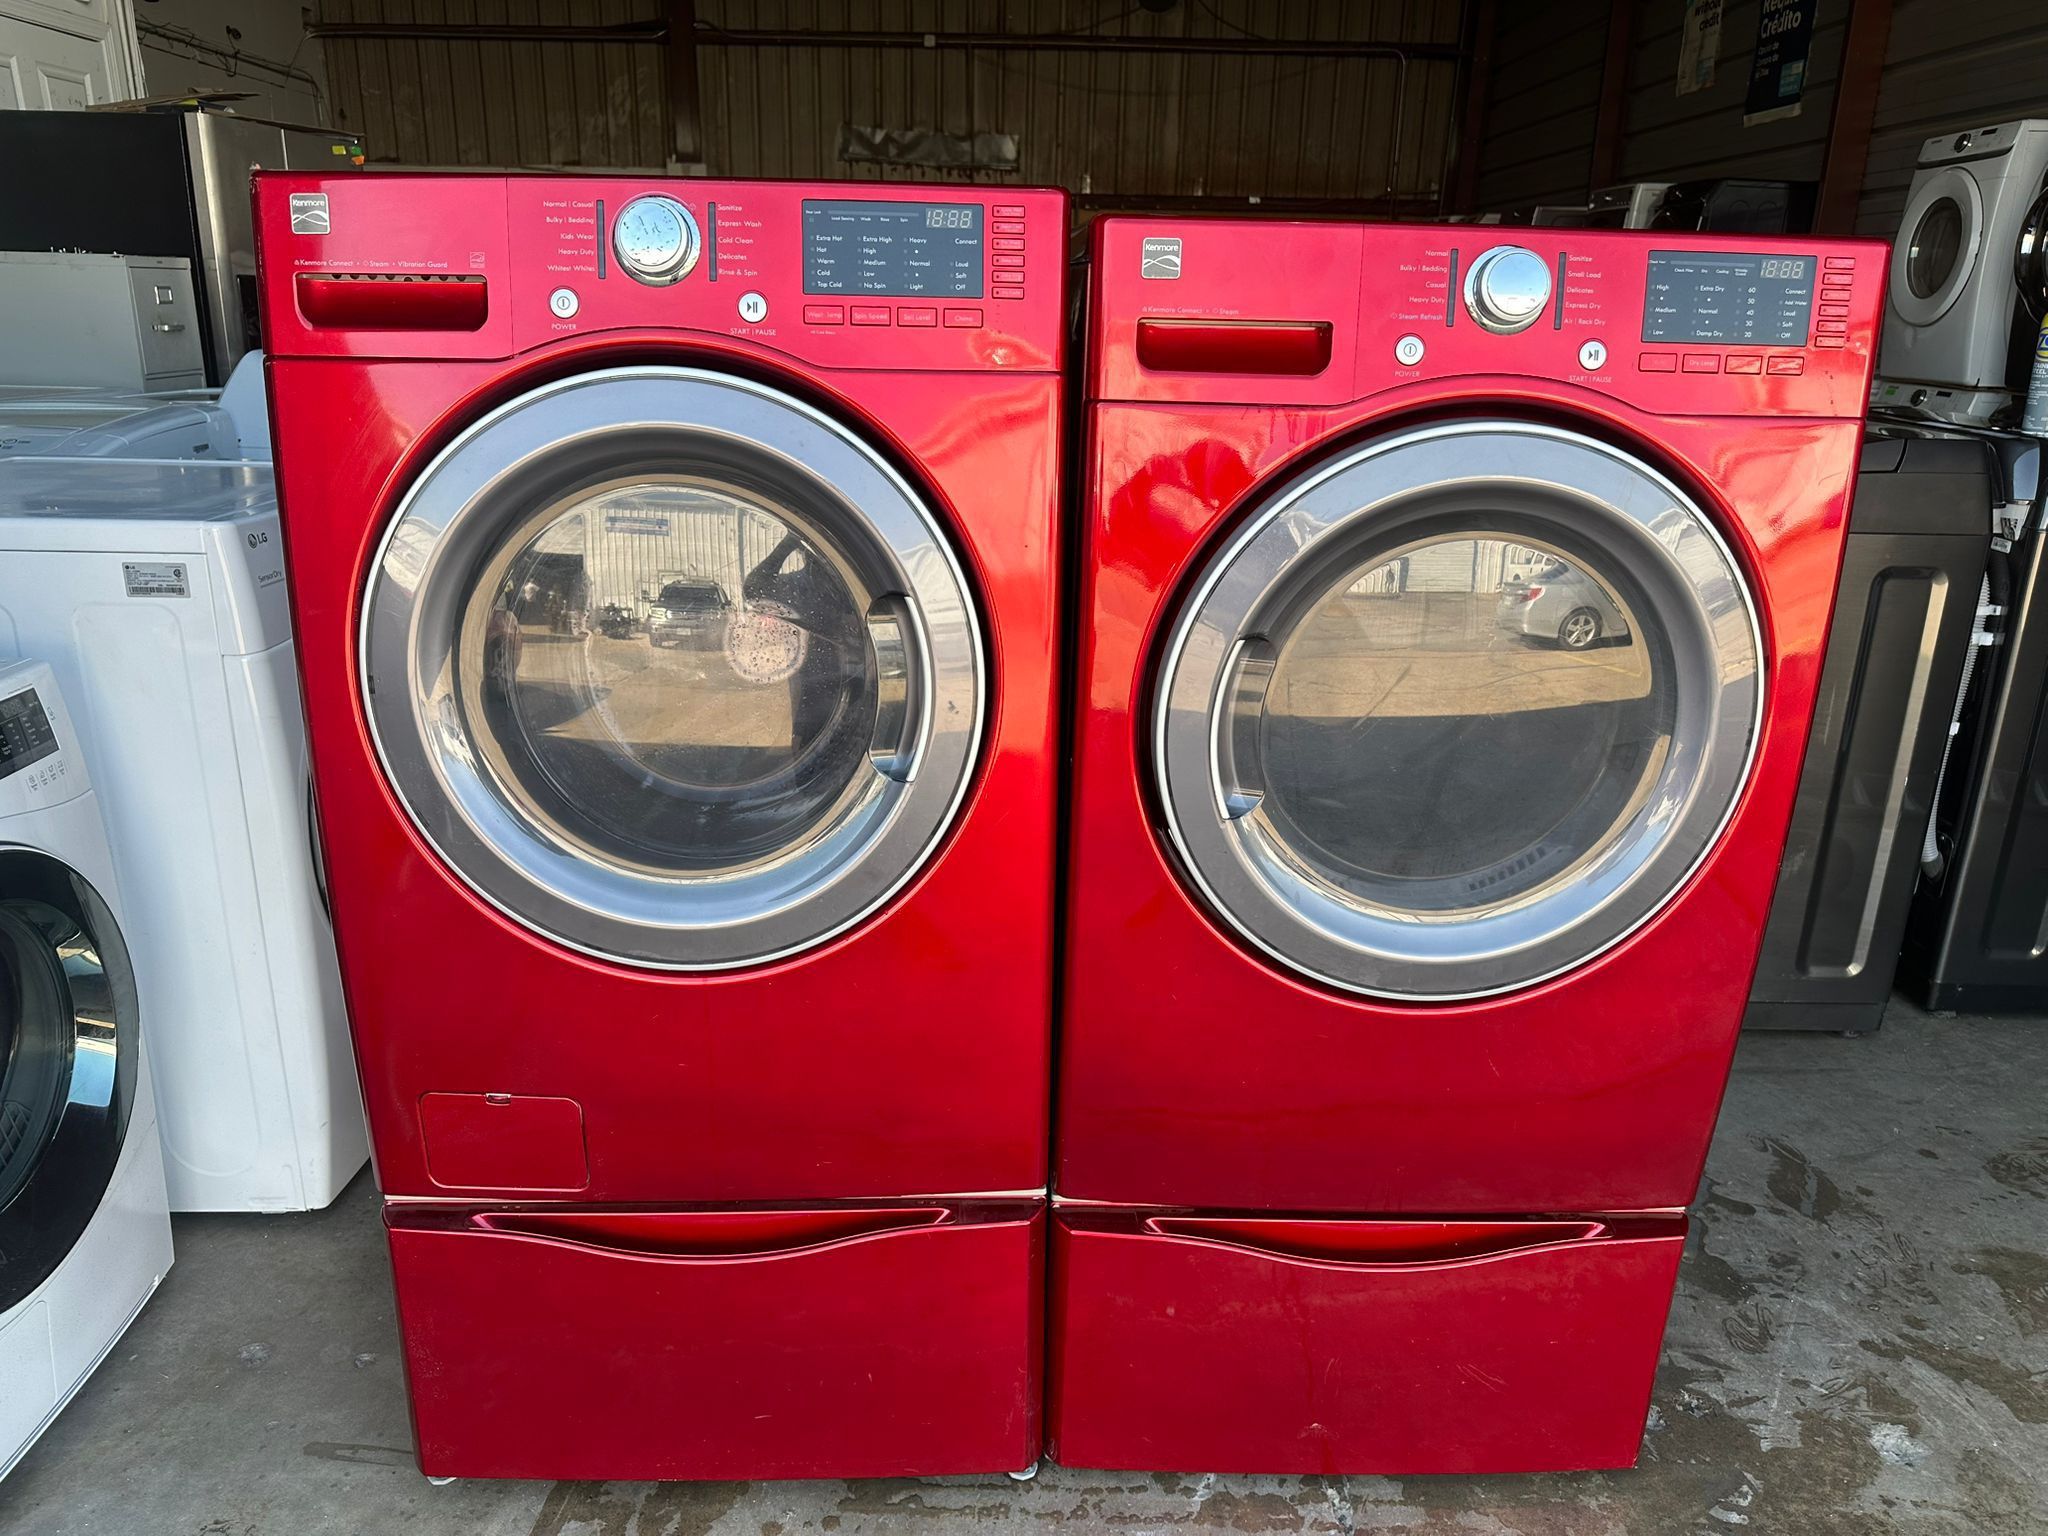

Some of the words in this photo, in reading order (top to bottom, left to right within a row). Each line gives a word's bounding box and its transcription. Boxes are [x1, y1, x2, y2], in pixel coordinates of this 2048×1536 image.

[1761, 9, 1801, 38] Crédito
[292, 199, 325, 207] Kenmore
[718, 220, 742, 228] Express
[744, 220, 762, 228] Wash
[718, 236, 733, 244] Cold
[878, 236, 892, 244] High
[1145, 243, 1179, 251] Kenmore
[369, 260, 389, 268] Steam
[428, 261, 448, 269] Guard
[718, 268, 734, 276] Rinse
[744, 269, 758, 277] Spin
[1422, 265, 1448, 273] Bedding
[910, 283, 924, 291] Light
[1425, 281, 1447, 289] Casual
[1409, 296, 1430, 304] Heavy
[1148, 306, 1176, 314] Kenmore
[1594, 318, 1606, 326] Dry
[551, 323, 577, 331] POWER
[730, 328, 750, 336] START
[1592, 376, 1612, 384] PAUSE
[257, 533, 268, 546] LG
